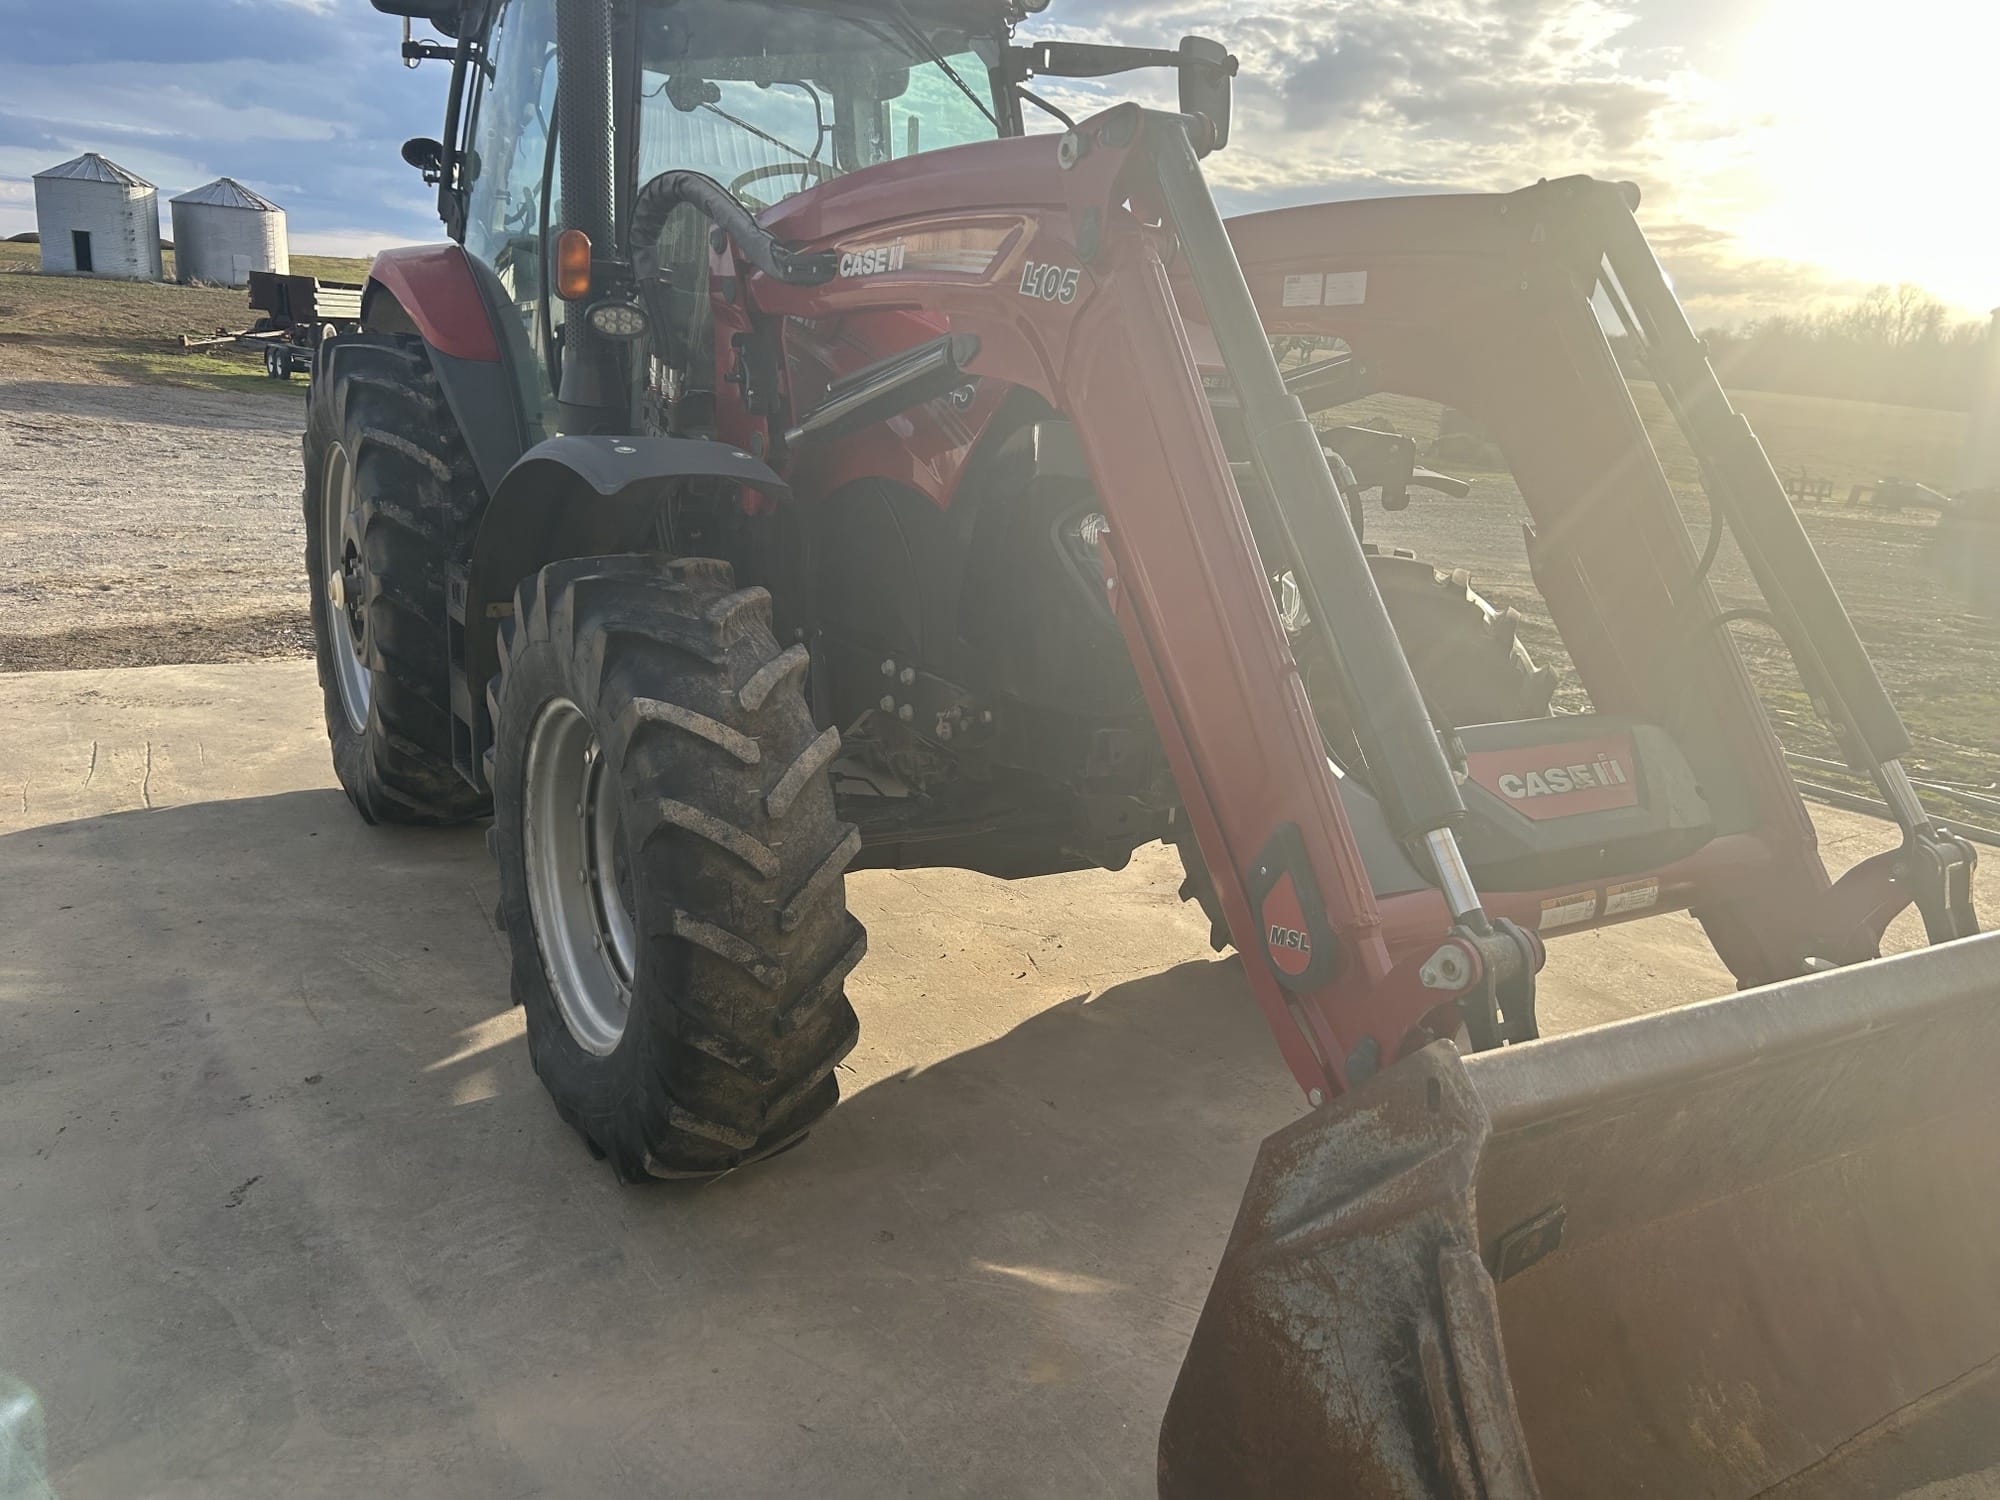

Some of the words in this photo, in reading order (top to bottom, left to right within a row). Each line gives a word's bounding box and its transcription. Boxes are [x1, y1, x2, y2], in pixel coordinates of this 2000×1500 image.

[840, 247, 888, 277] CASE
[1019, 261, 1080, 304] L105
[1498, 764, 1595, 798] CASE
[1269, 925, 1310, 953] MSL
